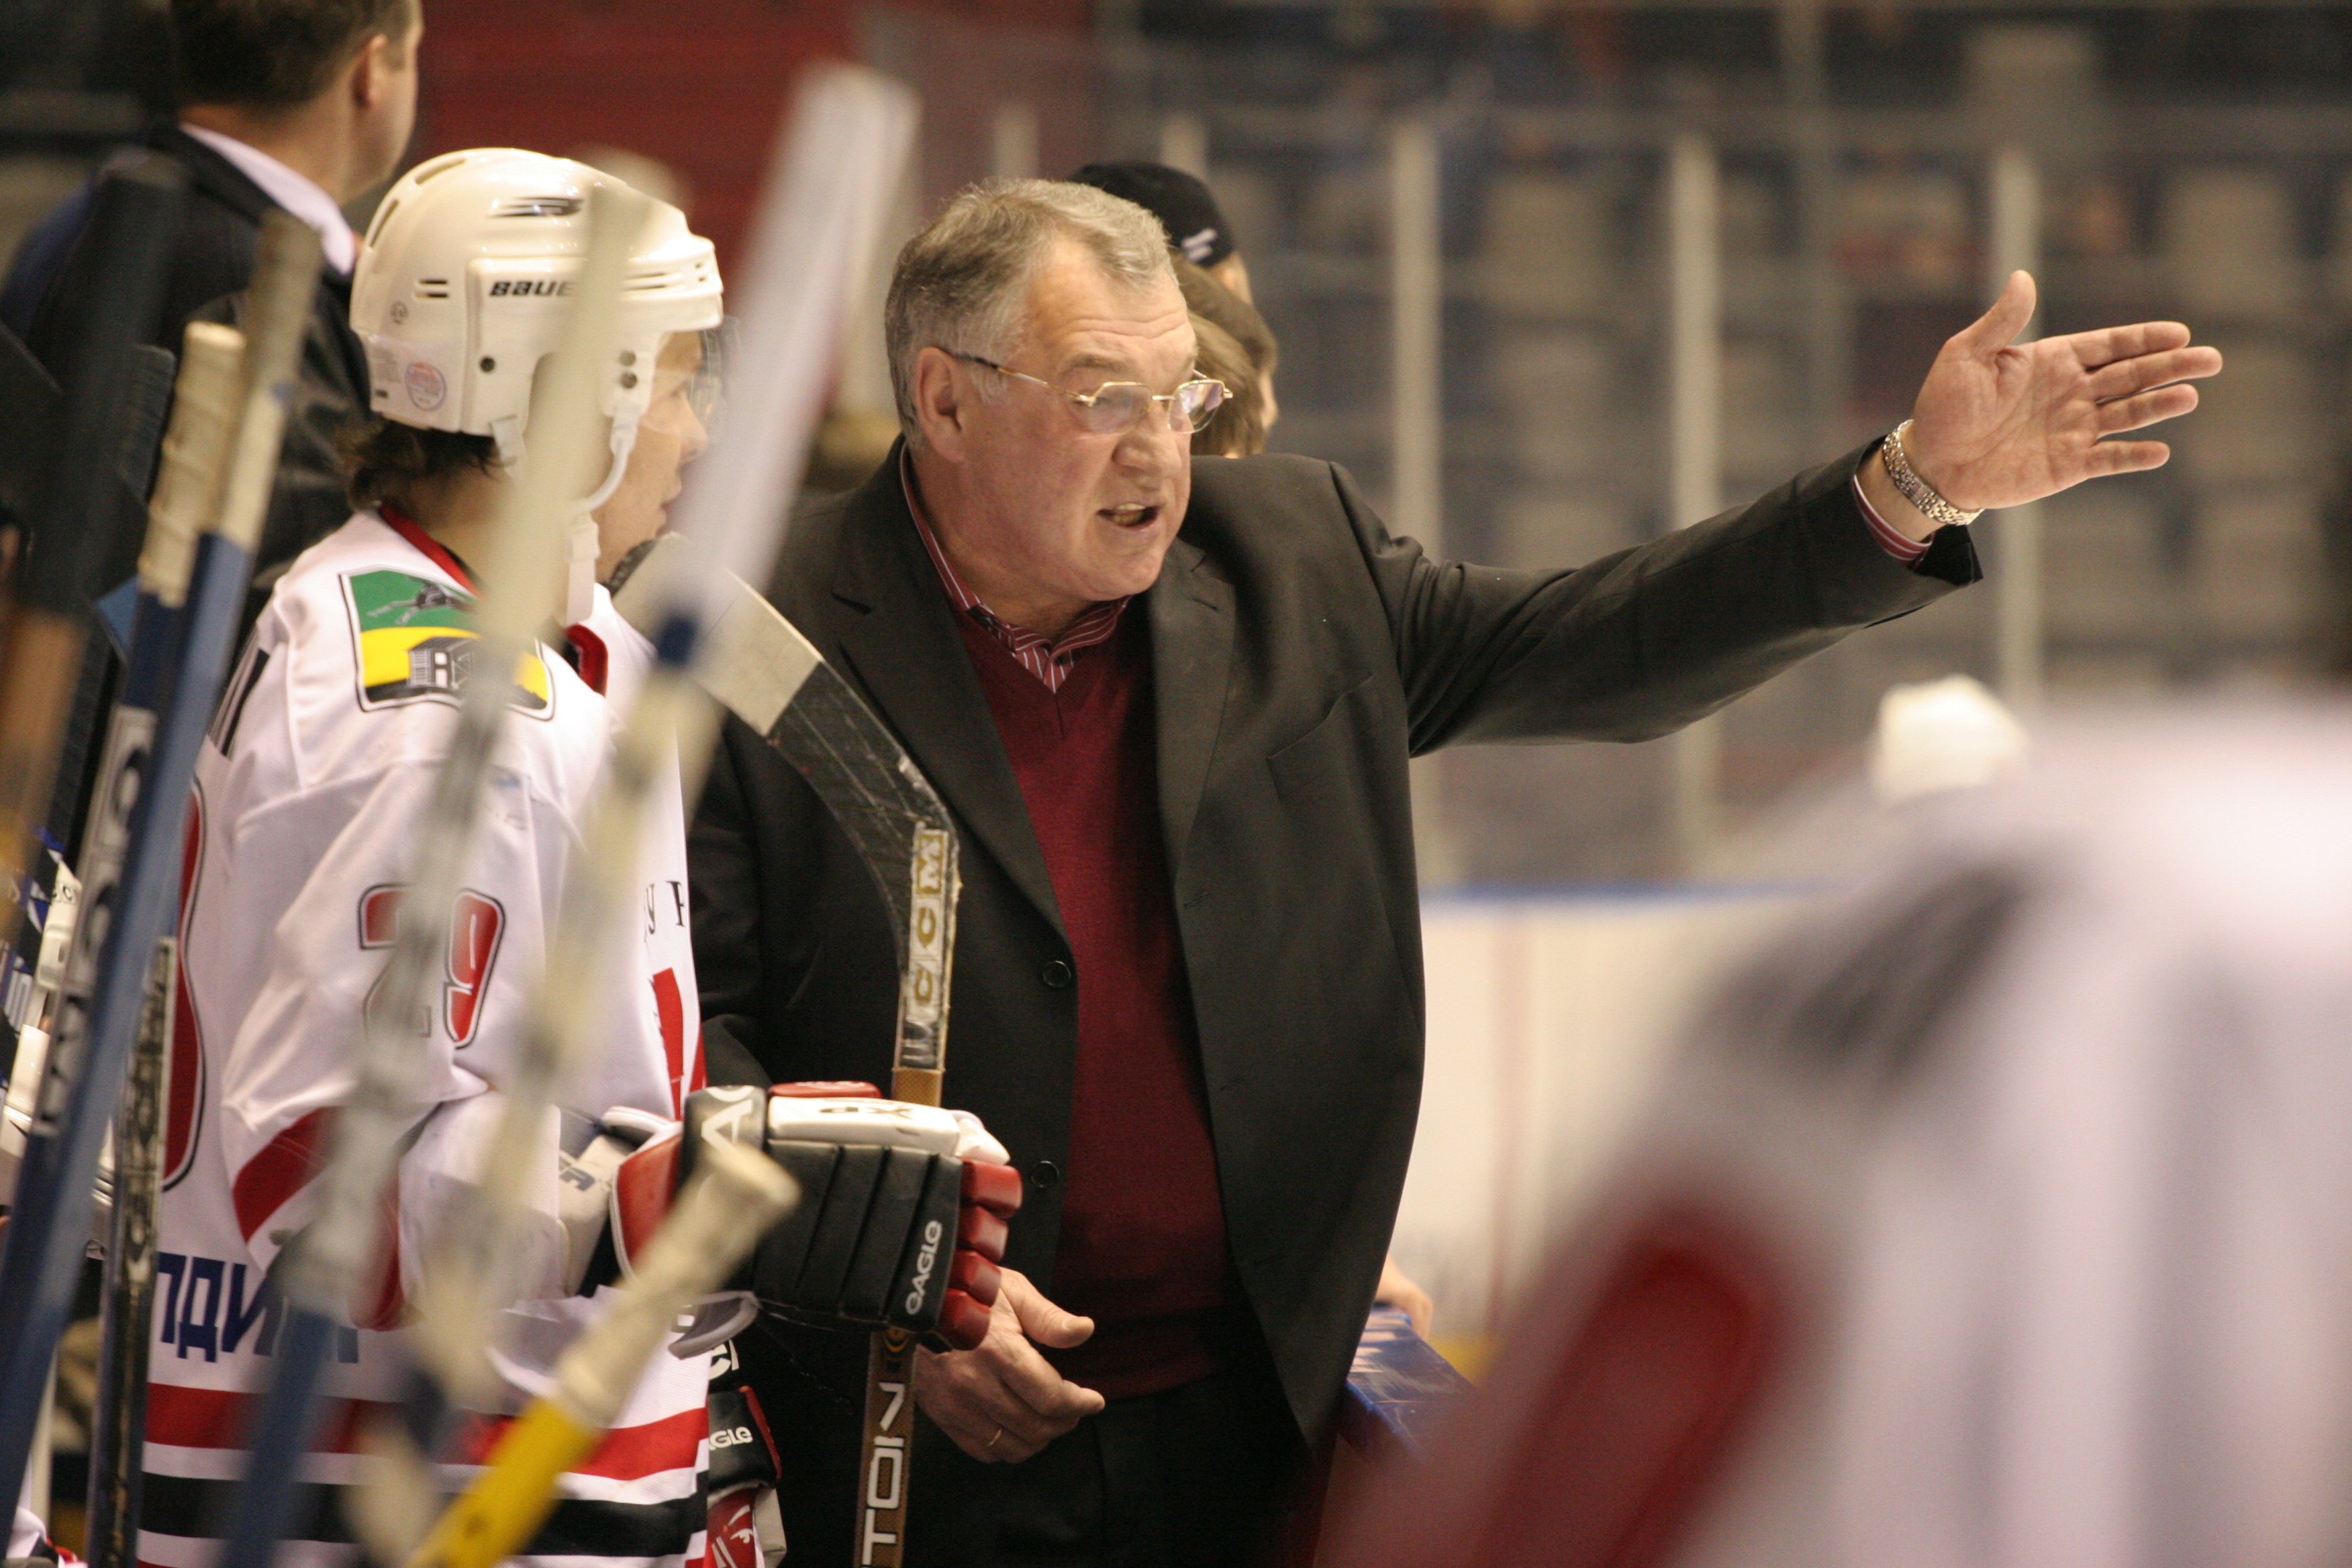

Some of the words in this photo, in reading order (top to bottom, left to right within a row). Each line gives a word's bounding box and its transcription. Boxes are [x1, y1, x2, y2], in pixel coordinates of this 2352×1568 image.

[490, 275, 579, 296] BAUE
[708, 1426, 752, 1451] GLe
[861, 1382, 905, 1566] TON
